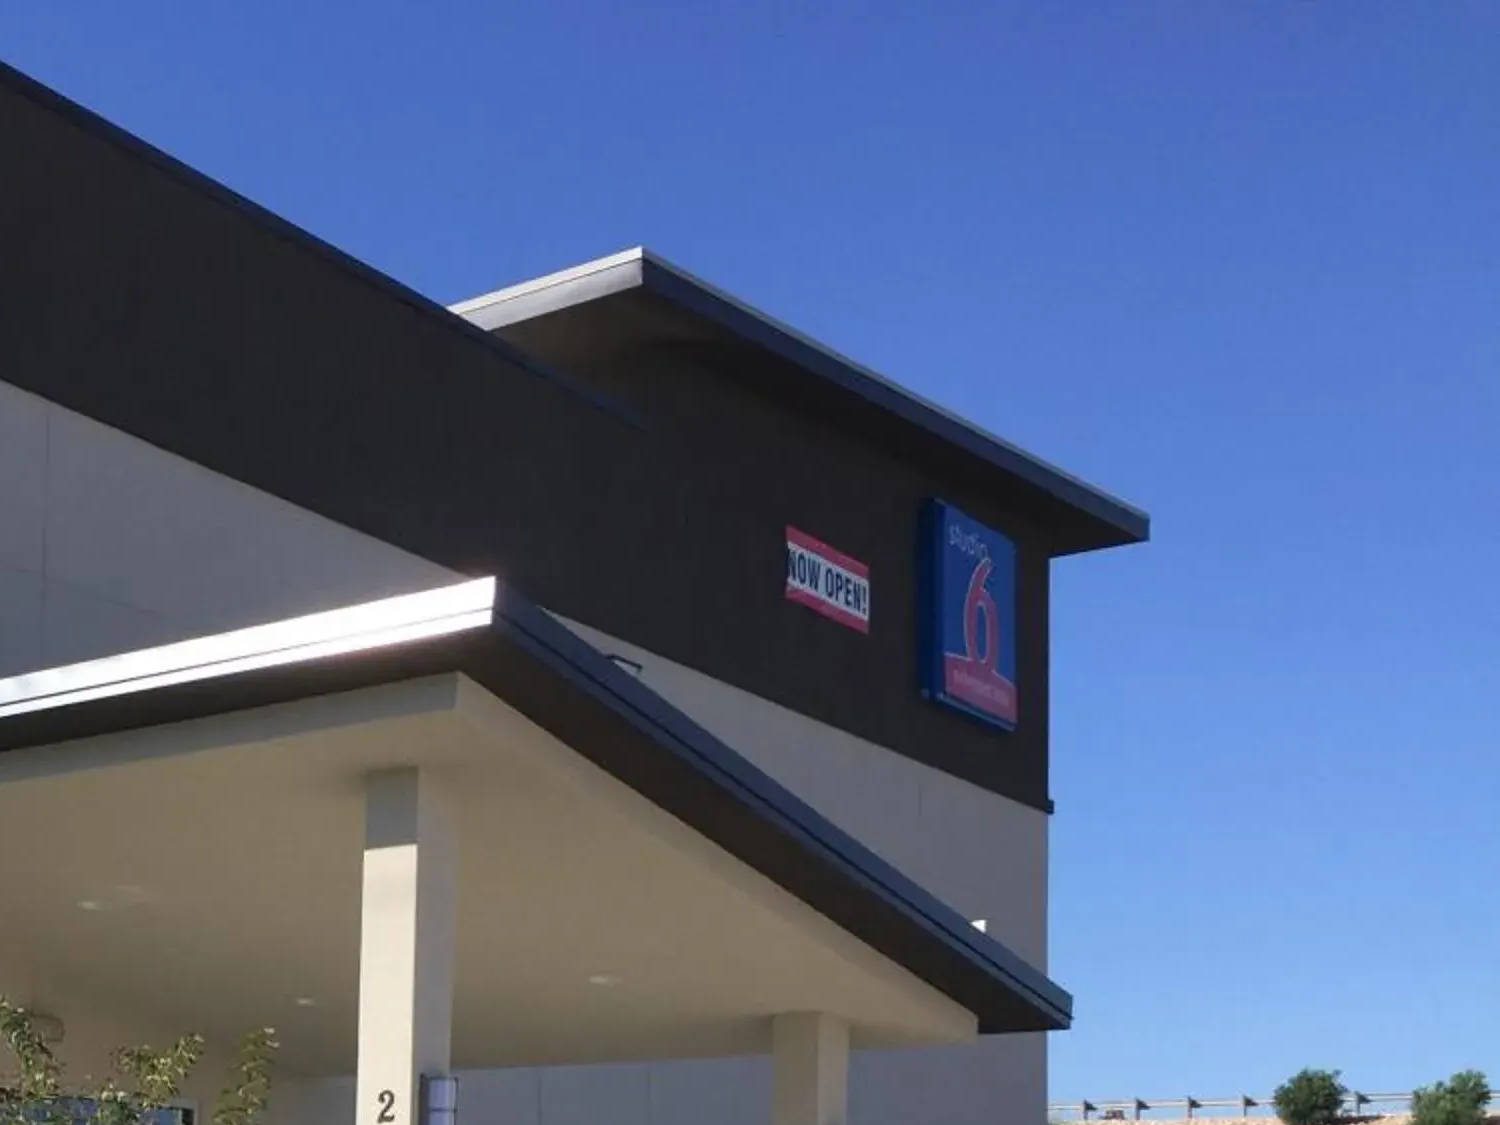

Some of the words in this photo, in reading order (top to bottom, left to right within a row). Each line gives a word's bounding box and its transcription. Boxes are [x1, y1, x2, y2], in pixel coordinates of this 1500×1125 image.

[786, 548, 821, 592] NOW
[825, 567, 867, 616] OPEN!
[963, 557, 999, 669] 6
